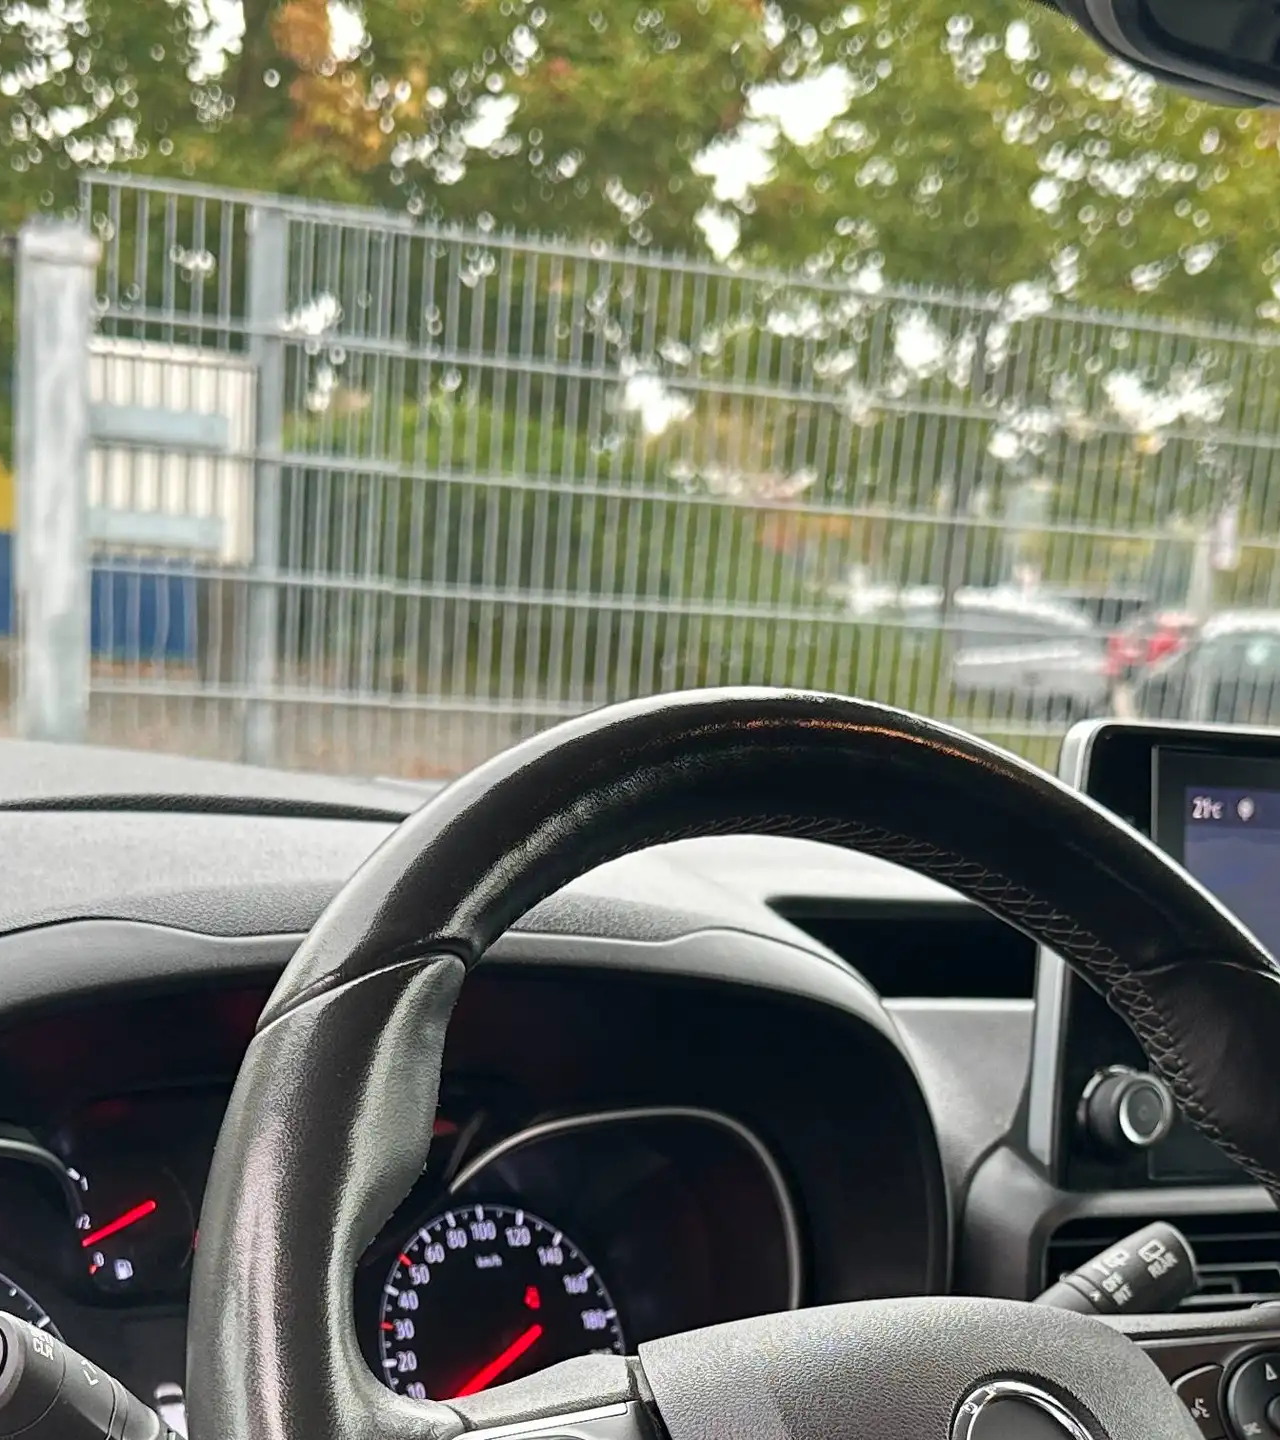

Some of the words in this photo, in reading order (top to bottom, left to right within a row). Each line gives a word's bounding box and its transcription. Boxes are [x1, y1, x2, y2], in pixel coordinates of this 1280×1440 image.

[446, 1228, 468, 1249] 80
[471, 1220, 497, 1241] 100
[505, 1226, 531, 1247] 120
[424, 1242, 445, 1264] 60
[537, 1245, 563, 1266] 140
[408, 1264, 430, 1286] 50
[398, 1289, 419, 1311] 40
[393, 1318, 415, 1340] 30
[396, 1350, 418, 1372] 20
